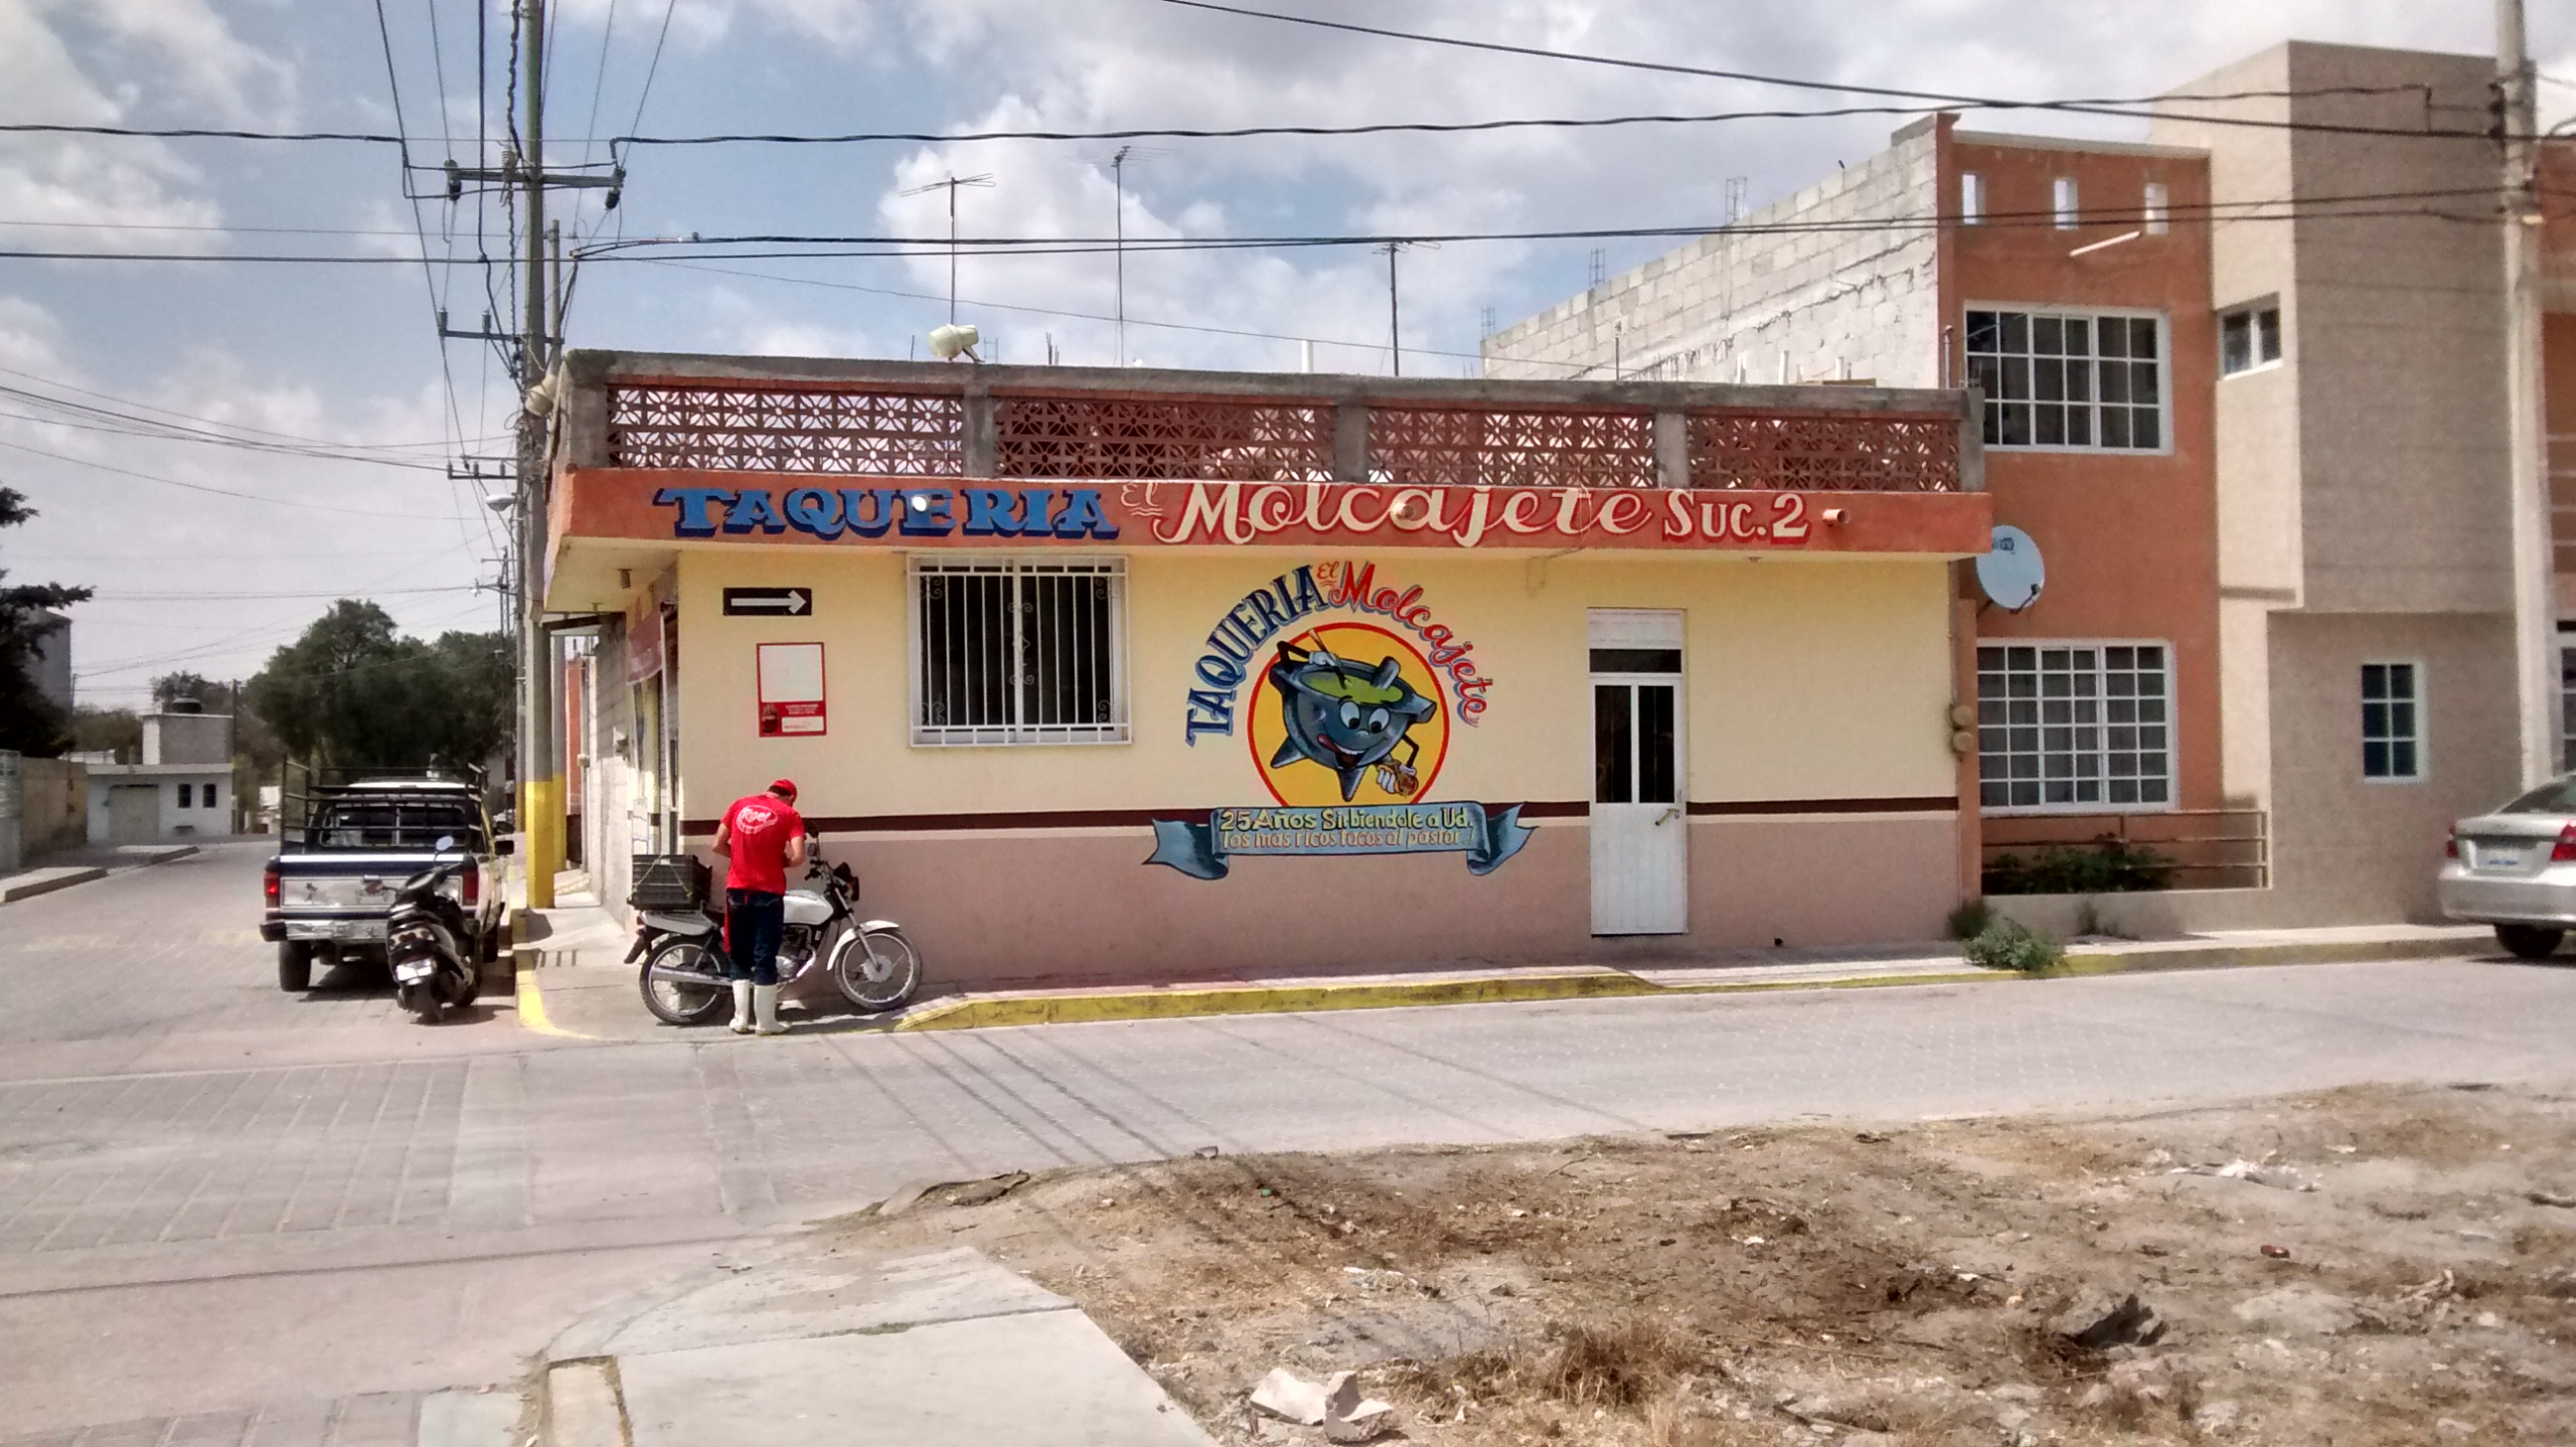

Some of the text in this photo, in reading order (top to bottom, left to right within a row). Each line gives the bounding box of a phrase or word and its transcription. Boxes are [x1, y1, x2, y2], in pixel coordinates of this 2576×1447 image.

[652, 487, 1119, 541] TAQUERIA
[1120, 482, 1161, 508] El
[1153, 483, 1652, 547] Molcajete
[1769, 492, 1811, 545] 2
[1186, 561, 1494, 747] TAQUERIA El Molcajete
[1219, 809, 1252, 832] 25
[1251, 808, 1318, 831] Años
[1440, 807, 1474, 830] Ud.
[1253, 831, 1292, 849] mas
[1295, 829, 1337, 848] ricos
[1339, 828, 1383, 847] tacos
[1384, 827, 1403, 847] al
